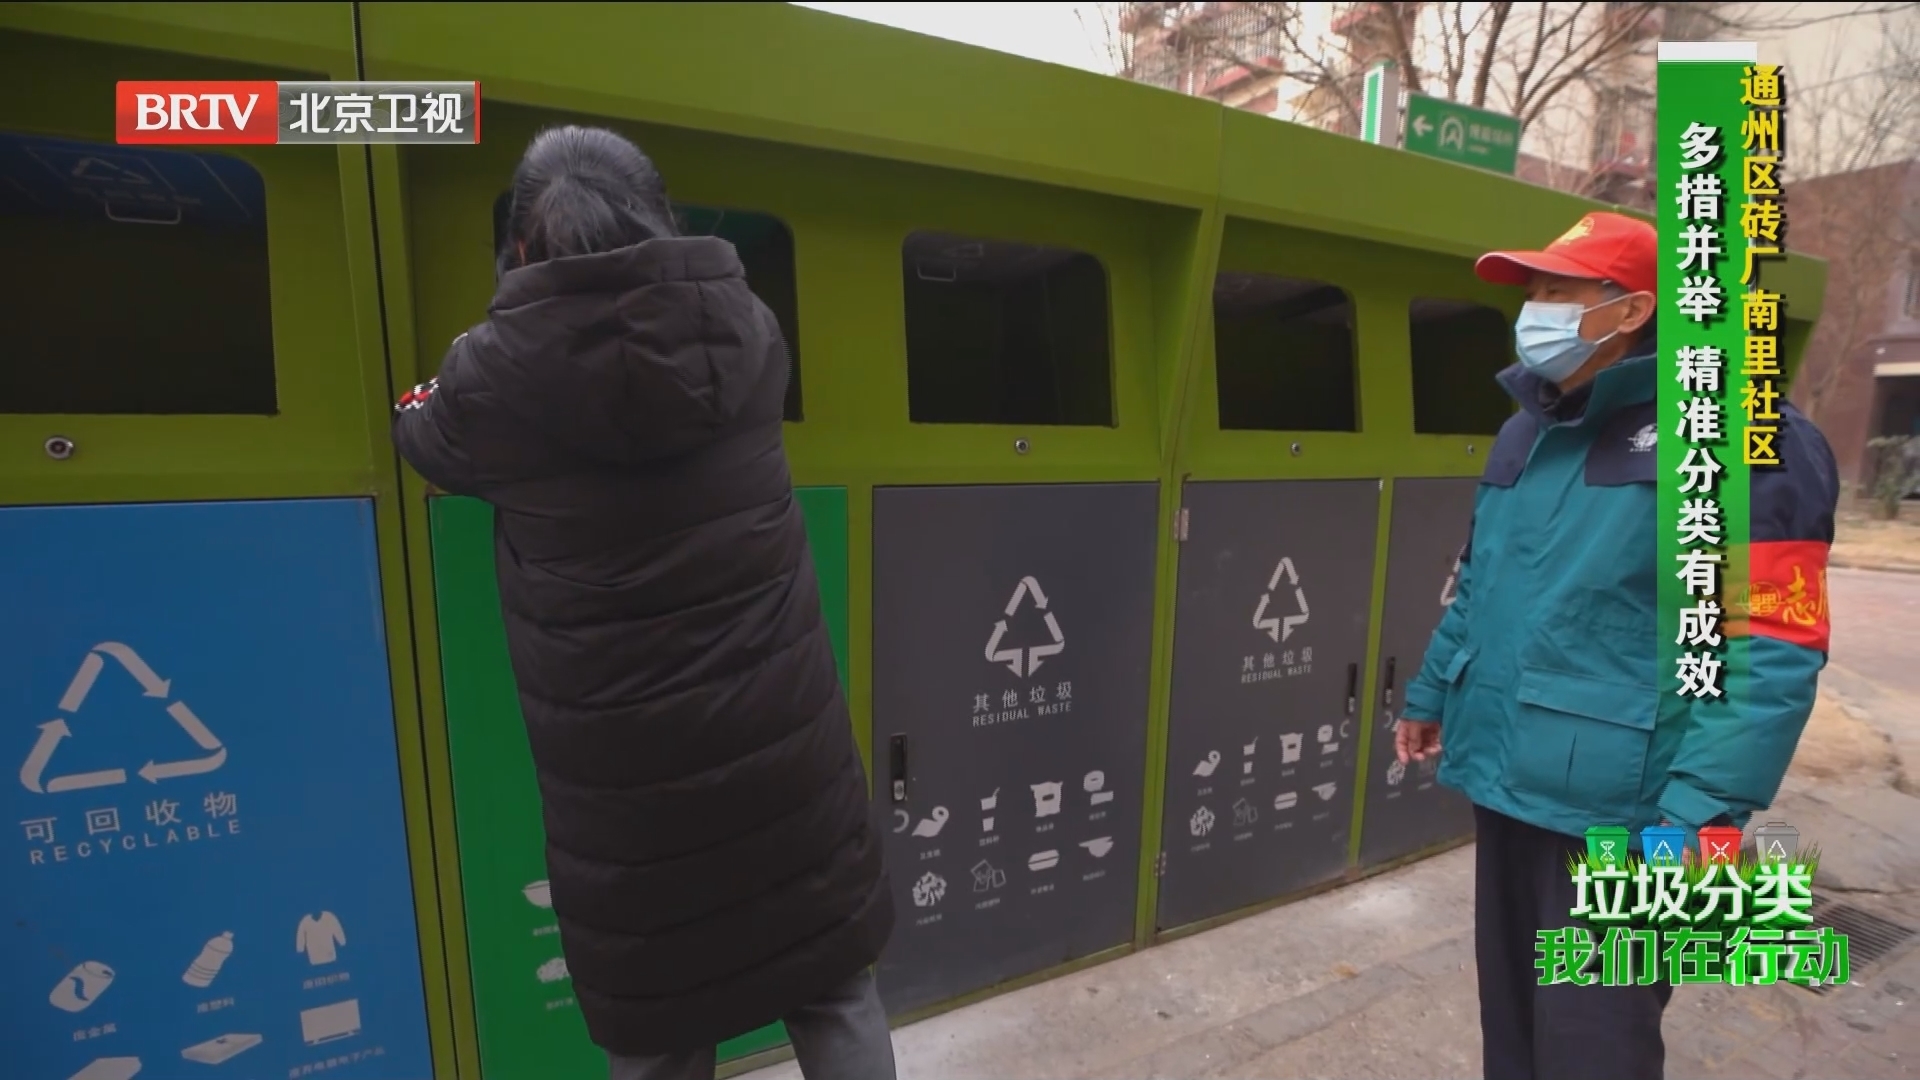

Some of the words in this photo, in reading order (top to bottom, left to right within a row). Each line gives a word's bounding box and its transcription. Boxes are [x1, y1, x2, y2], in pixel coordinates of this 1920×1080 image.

[1243, 646, 1313, 672] 其他垃圾
[1241, 668, 1281, 684] RESIDUAL
[973, 681, 1072, 713] 其他垃圾
[972, 708, 1030, 727] RESIDUAL
[1037, 701, 1072, 716] WASTE
[20, 791, 238, 844] 可回收物
[30, 819, 242, 865] RECYCLABLE
